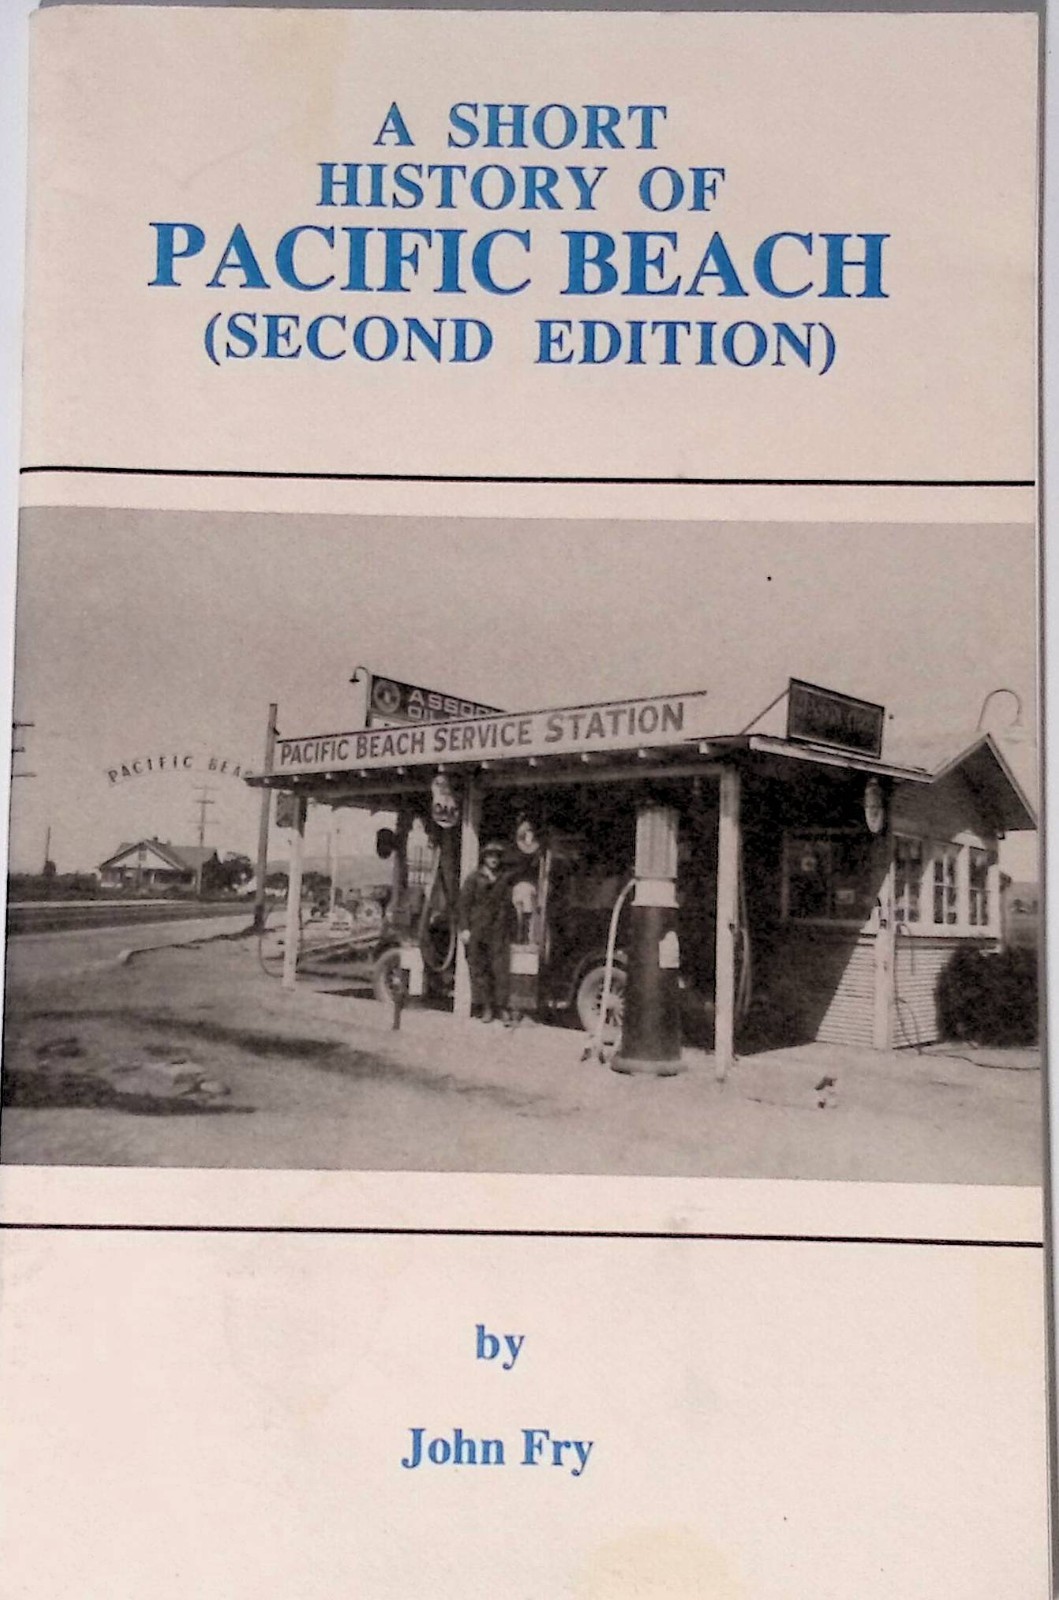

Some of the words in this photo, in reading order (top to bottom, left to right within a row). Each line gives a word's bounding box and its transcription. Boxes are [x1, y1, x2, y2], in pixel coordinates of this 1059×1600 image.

[373, 101, 415, 147] A
[448, 102, 668, 151] SHORT
[316, 162, 607, 212] HISTORY
[640, 167, 726, 213] OF
[148, 222, 533, 298] PACIFIC
[560, 230, 891, 300] BEACH
[204, 313, 495, 366] (SECOND
[537, 320, 838, 375] EDITION)
[280, 739, 349, 766] PACIFIC
[356, 731, 426, 760] BEACH
[433, 719, 533, 753] SERVICE
[544, 702, 685, 743] STATION
[107, 755, 194, 783] PACIFIC
[208, 757, 254, 779] BEA
[476, 1324, 525, 1370] by
[402, 1428, 505, 1469] John
[521, 1429, 594, 1477] Fry
